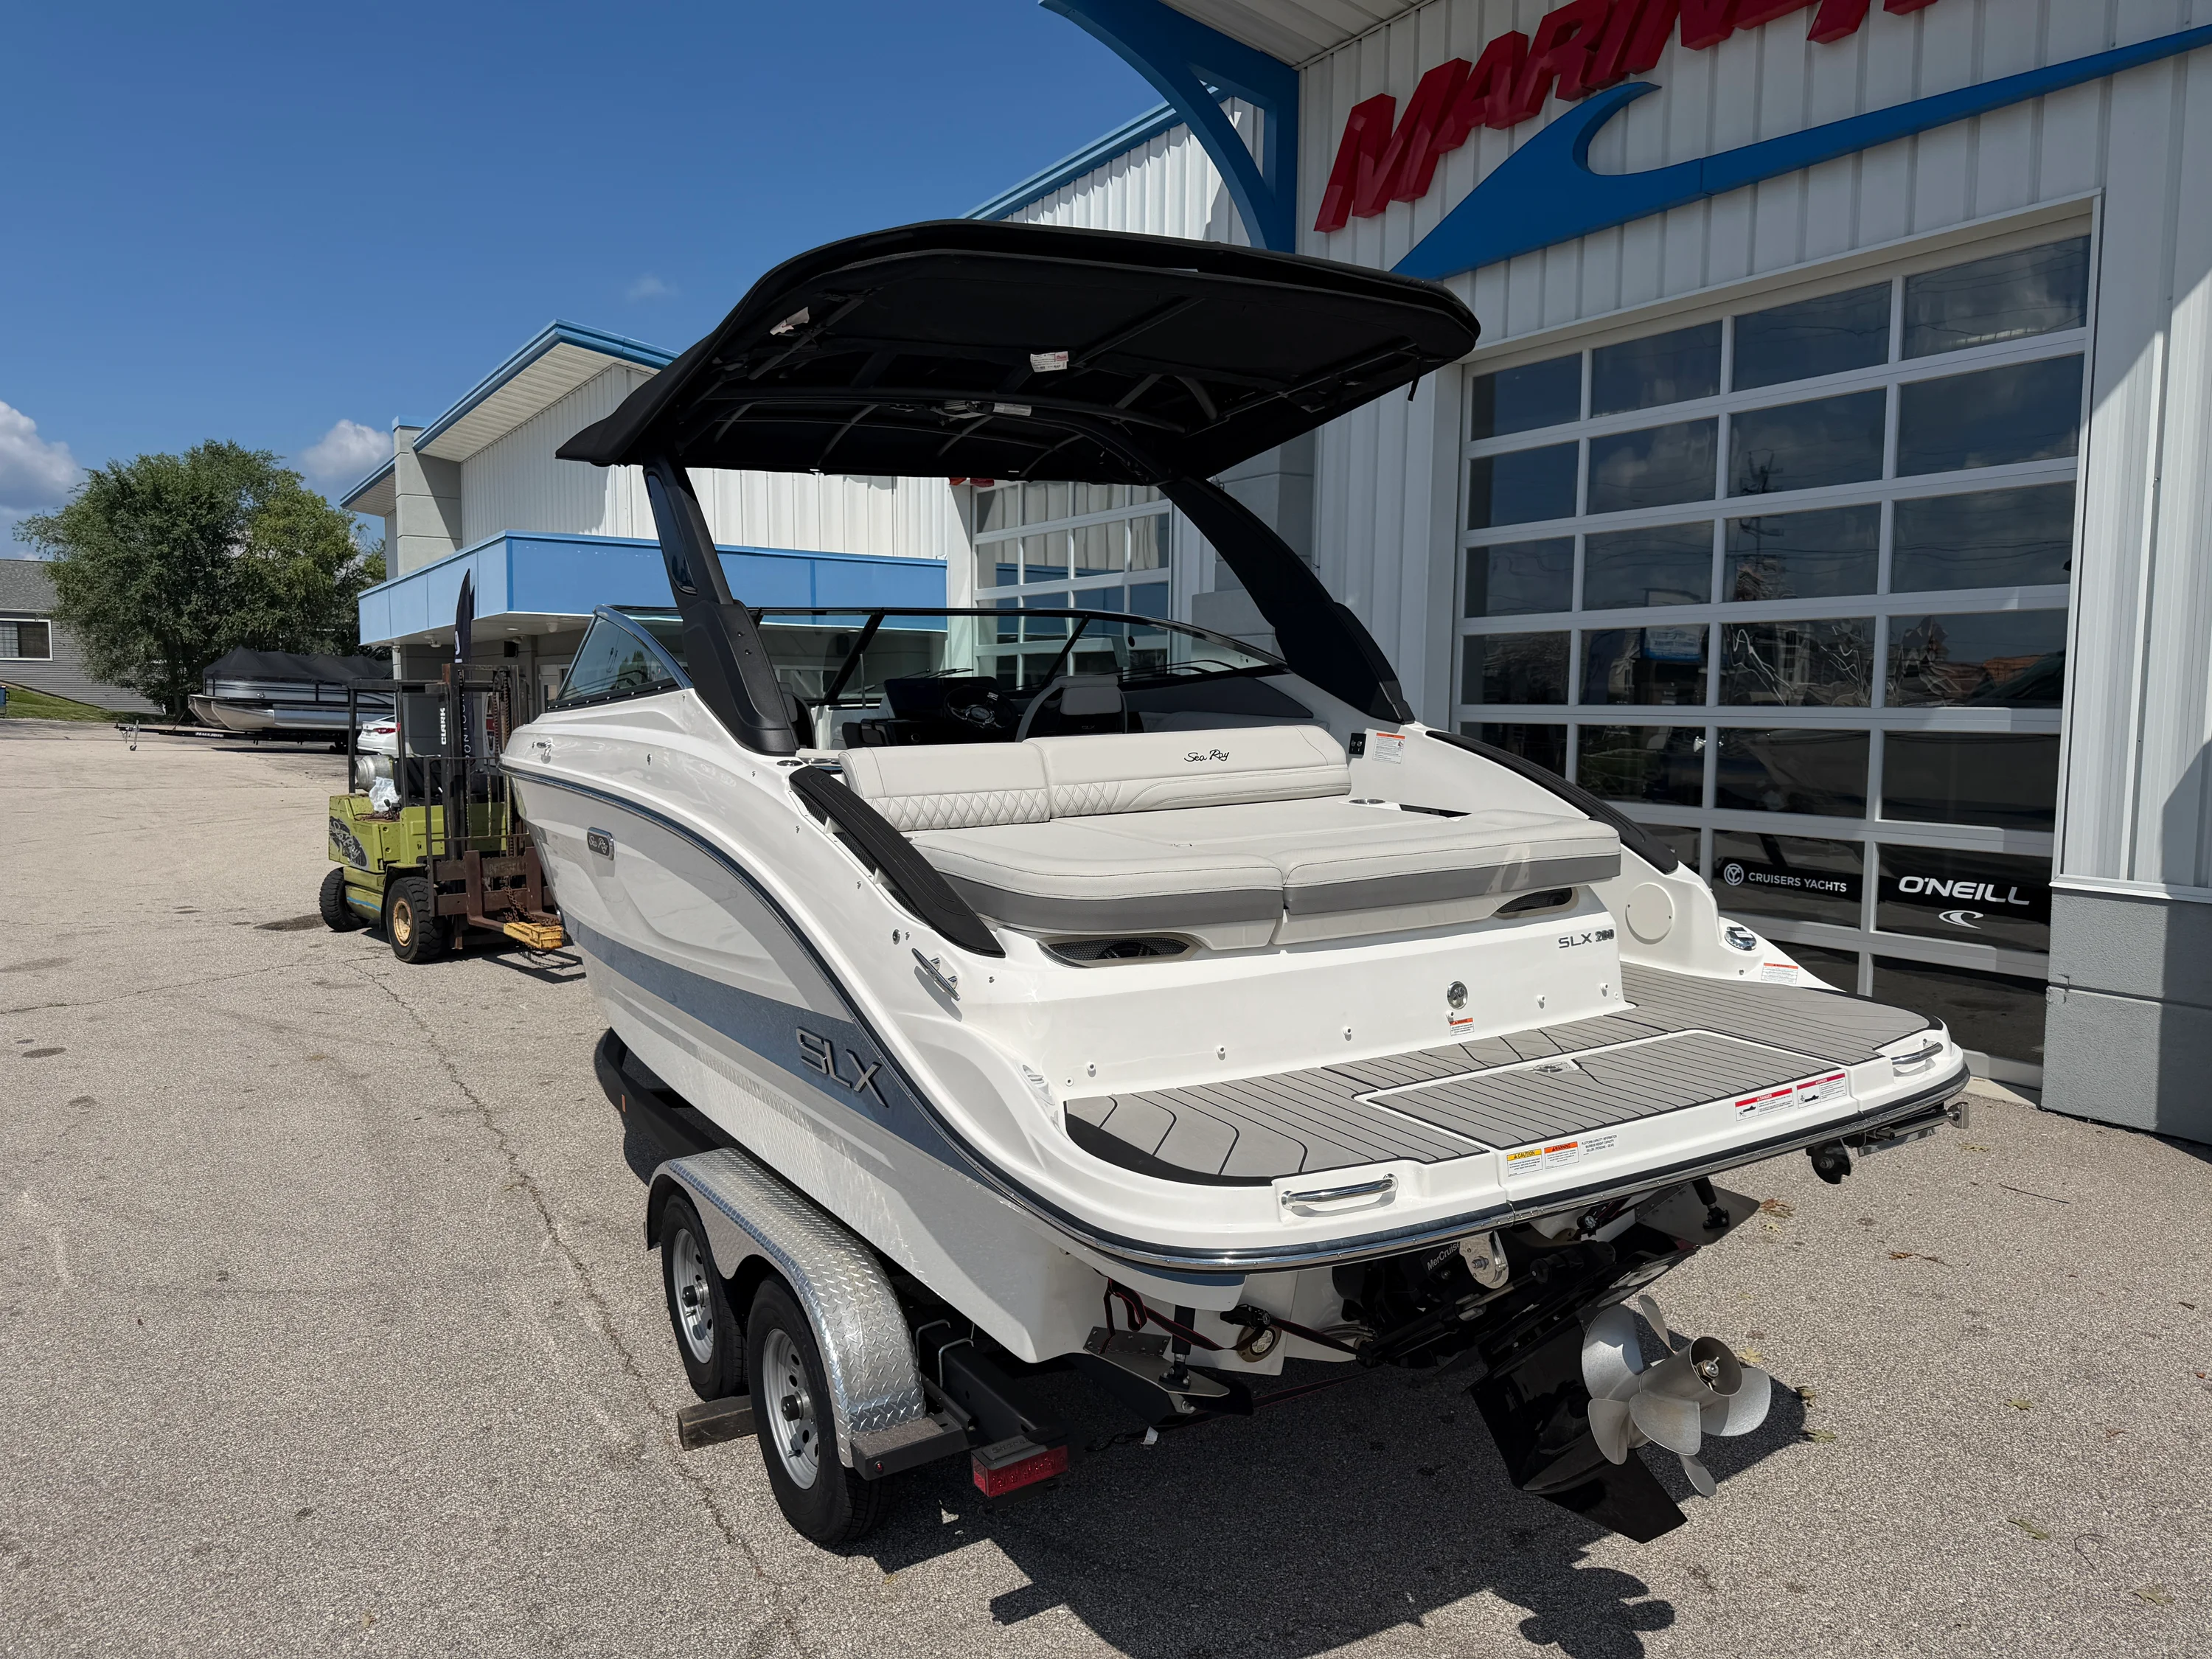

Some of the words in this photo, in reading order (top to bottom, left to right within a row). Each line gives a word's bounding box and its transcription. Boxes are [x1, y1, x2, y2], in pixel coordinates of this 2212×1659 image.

[1183, 751, 1207, 762] Sea
[1209, 748, 1229, 762] Ray
[589, 835, 597, 847] Sea
[597, 838, 608, 854] Ray
[1748, 872, 1801, 887] CRUISERS
[1804, 878, 1847, 893] YACHTS
[1898, 875, 2031, 905] O'NEILL
[1558, 932, 1593, 949] SLX
[796, 1026, 890, 1109] SLX
[1517, 1150, 1535, 1160] CAUTION
[1555, 1143, 1571, 1152] WARNING
